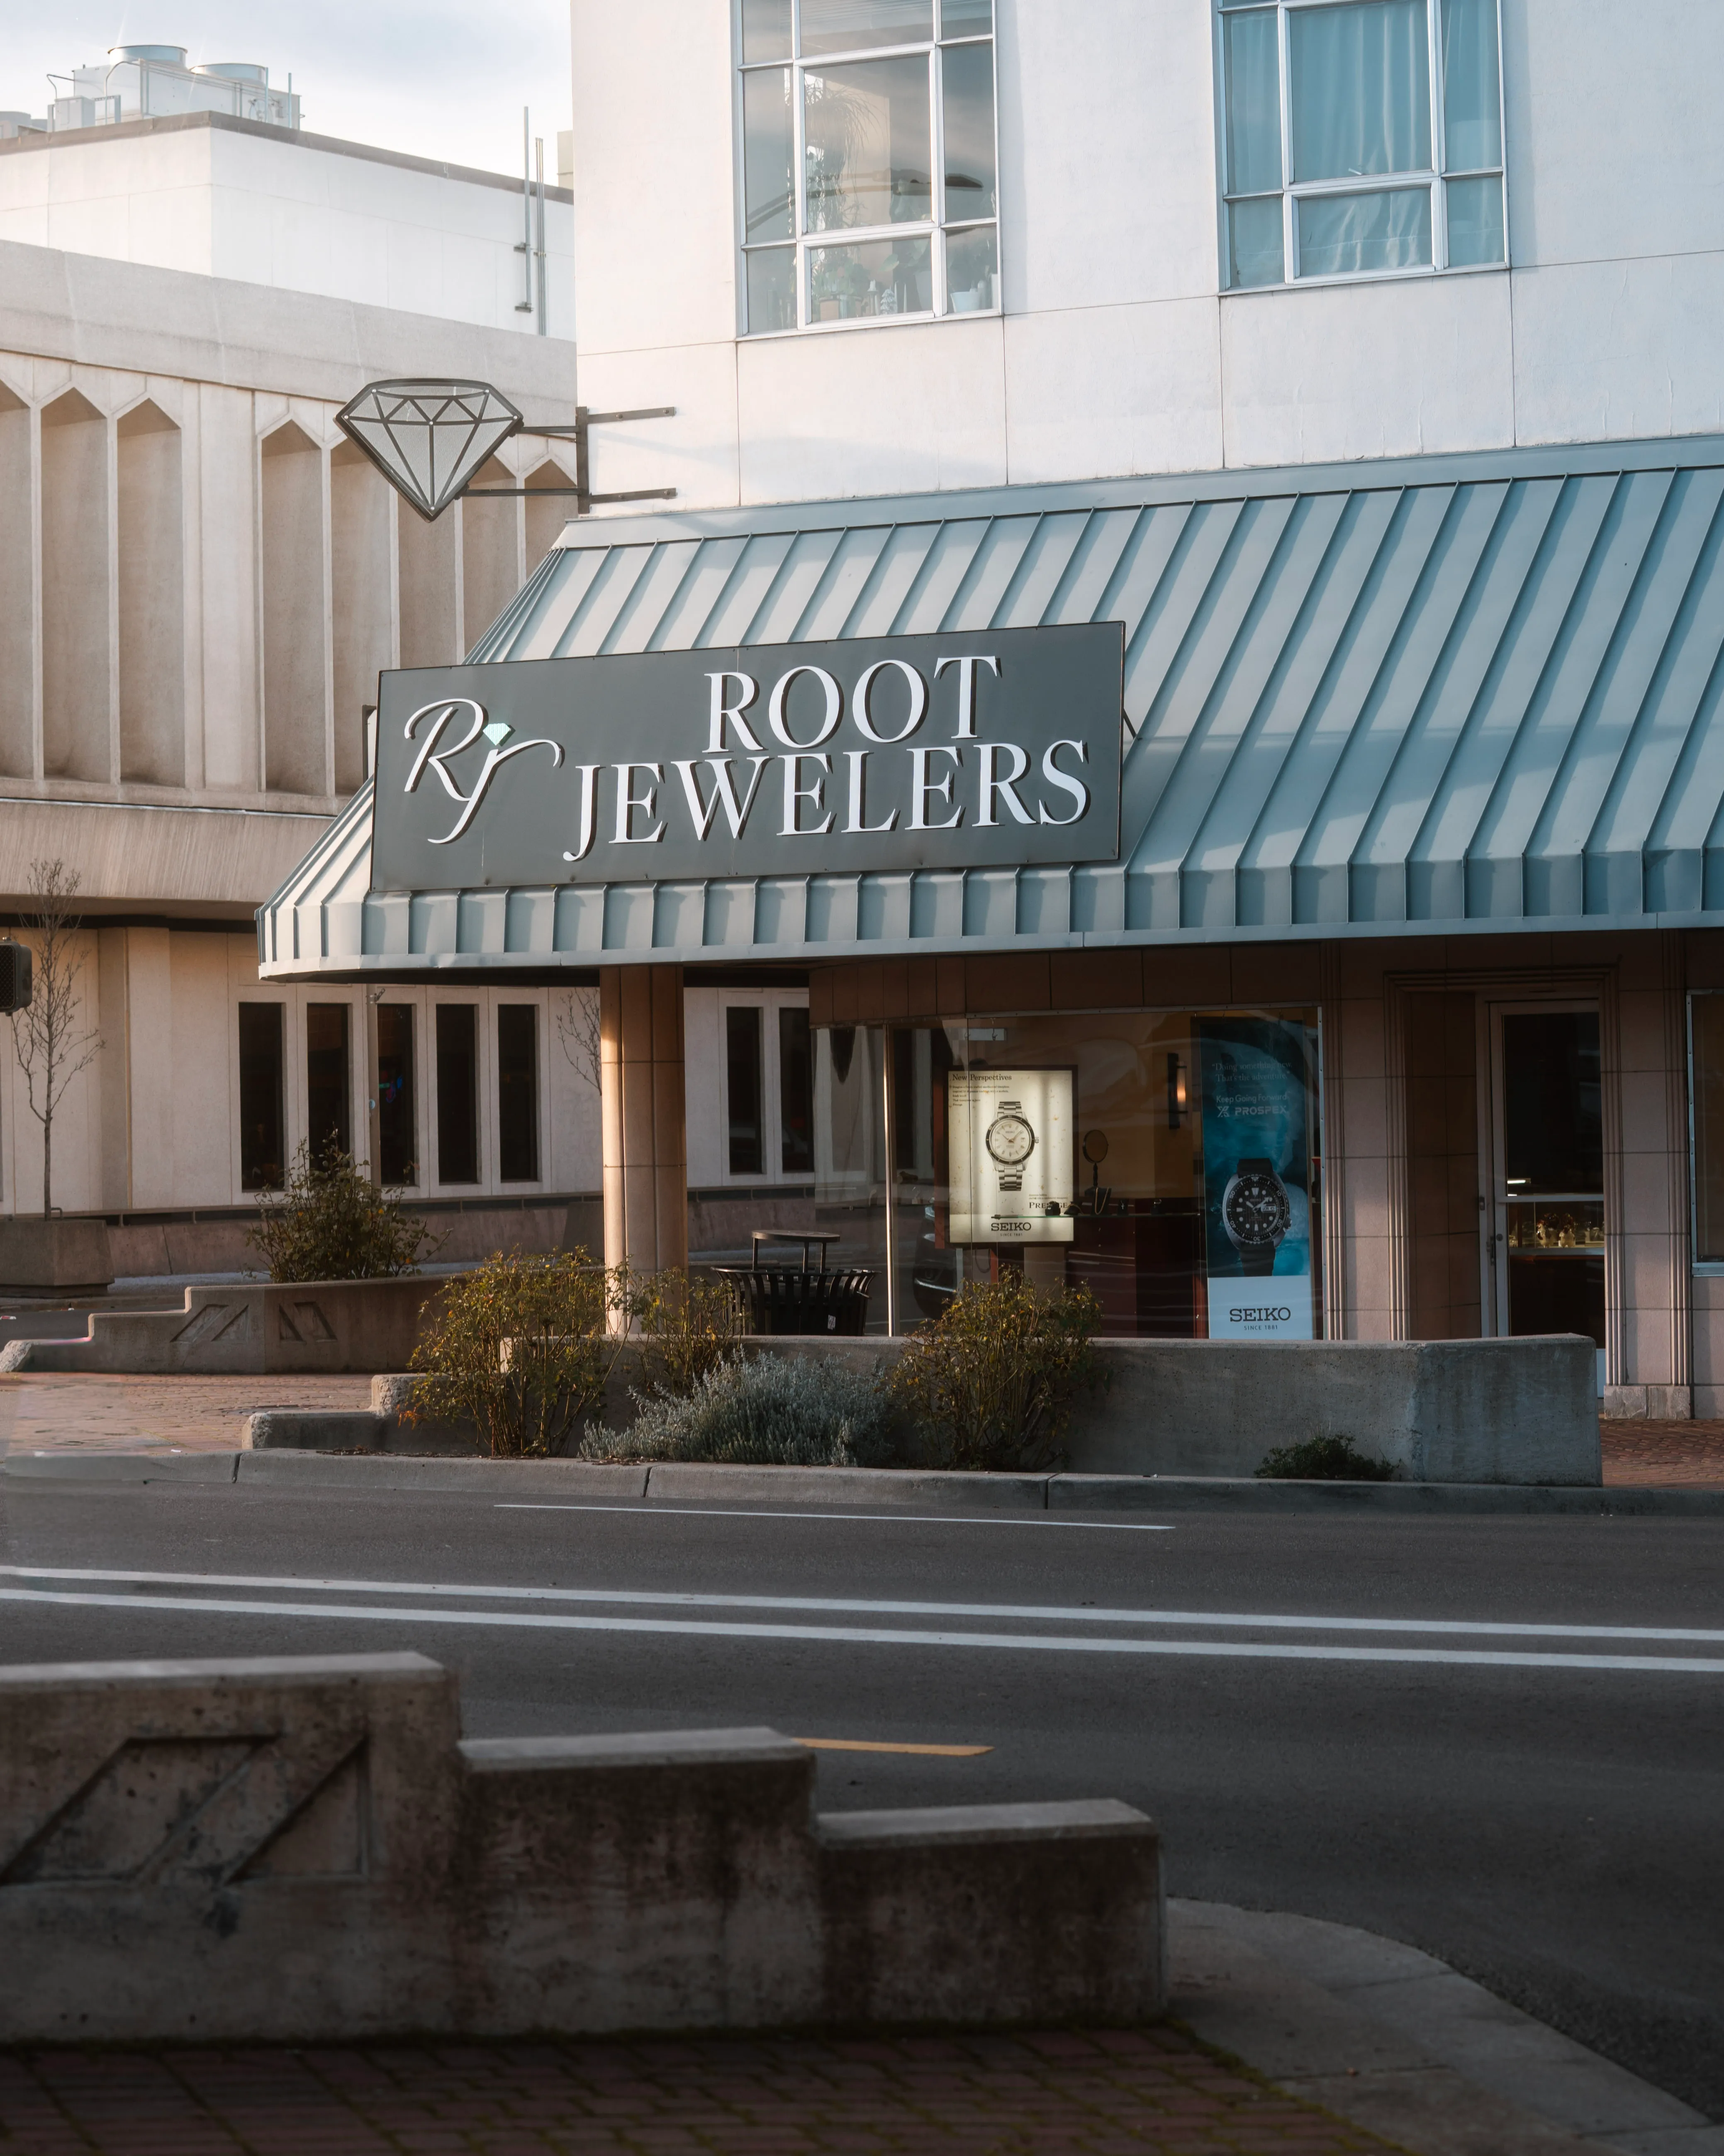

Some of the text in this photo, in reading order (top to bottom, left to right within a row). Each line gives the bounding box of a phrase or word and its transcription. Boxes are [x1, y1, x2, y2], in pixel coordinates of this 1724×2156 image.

[702, 656, 998, 753] ROOT
[563, 740, 1089, 862] JEWELERS
[1239, 1061, 1276, 1071] something
[970, 1073, 1012, 1082] Perspectives
[1216, 1092, 1287, 1104] Keep Going Forward
[1235, 1105, 1287, 1116] PROSPEX
[1229, 1191, 1235, 1199] 50
[991, 1222, 1031, 1231] SEIKO
[1230, 1307, 1291, 1322] SEIKO
